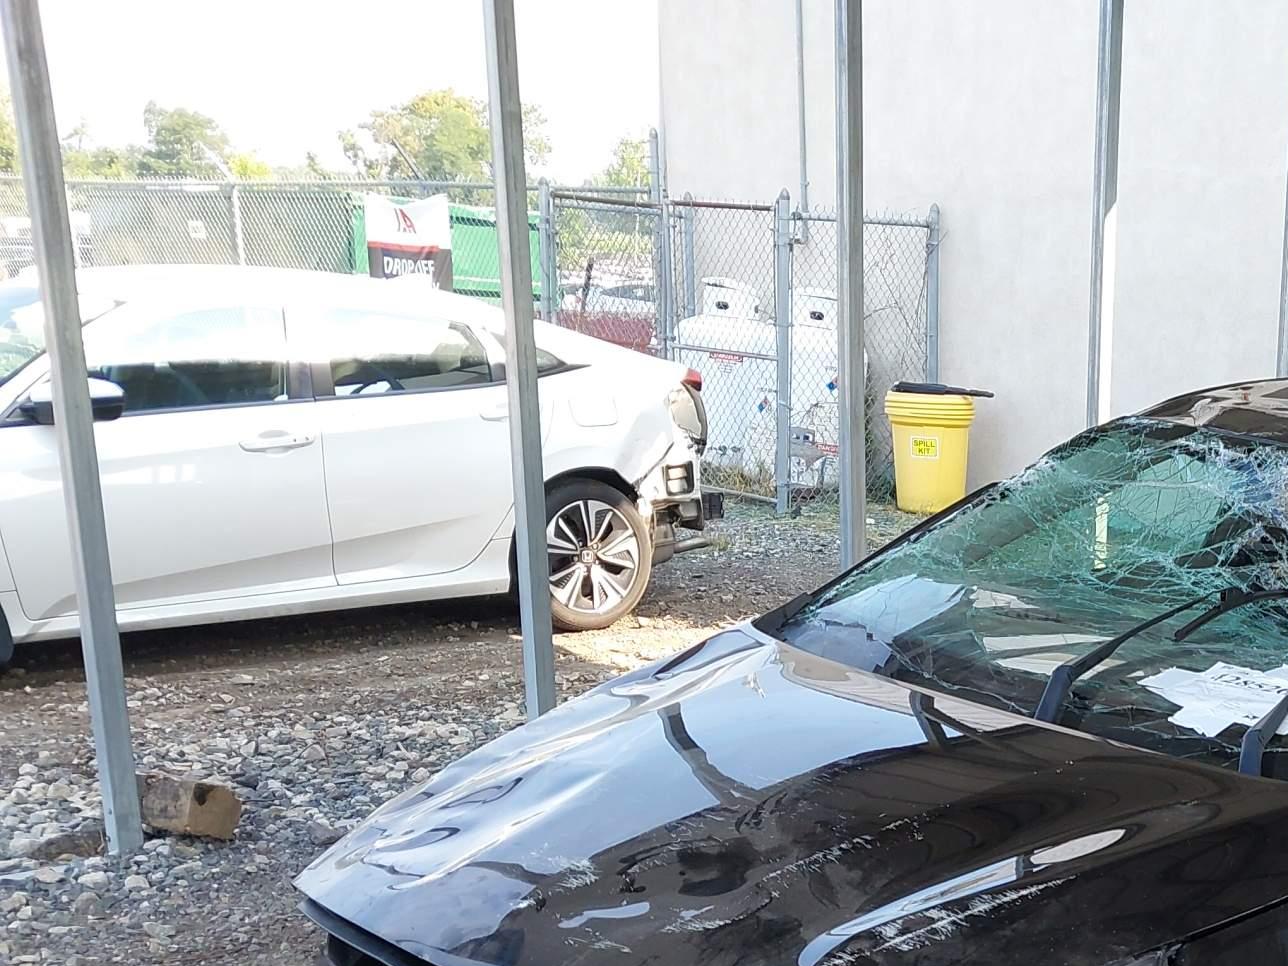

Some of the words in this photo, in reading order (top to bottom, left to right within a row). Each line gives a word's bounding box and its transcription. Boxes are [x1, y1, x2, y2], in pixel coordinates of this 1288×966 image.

[383, 256, 413, 275] DROP
[414, 259, 435, 275] OFF
[913, 439, 936, 448] SPILL
[918, 447, 931, 455] KIT
